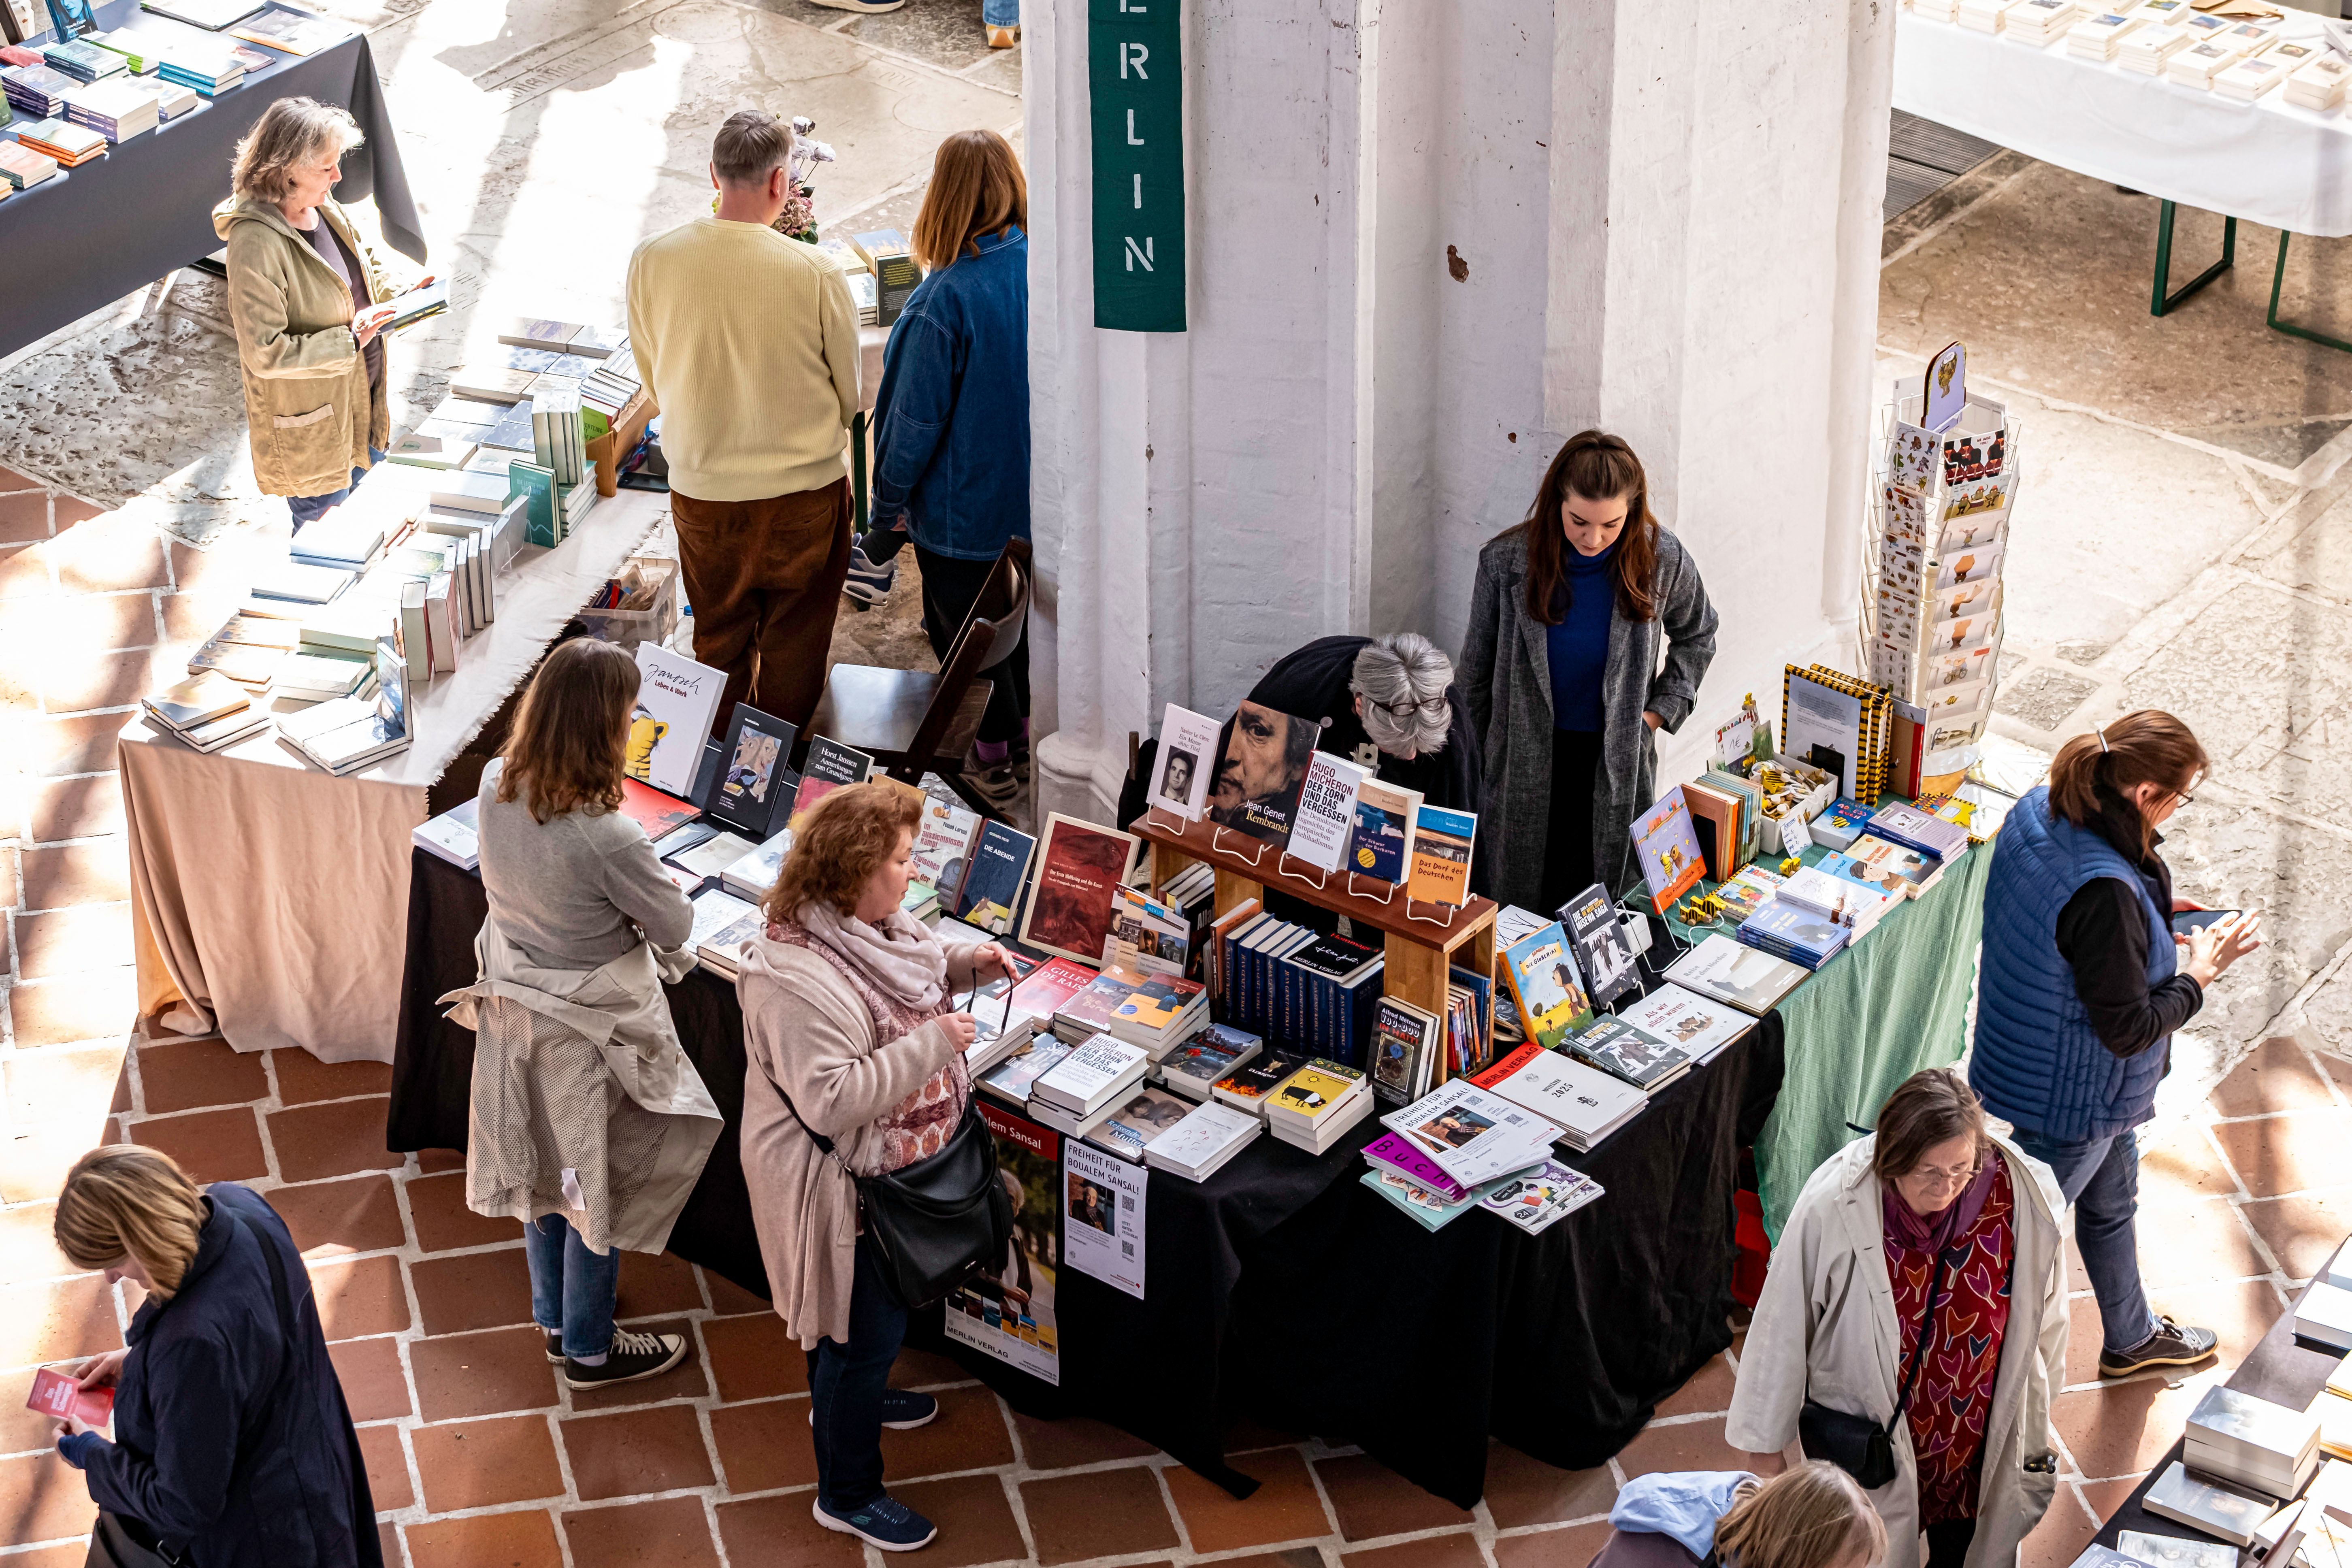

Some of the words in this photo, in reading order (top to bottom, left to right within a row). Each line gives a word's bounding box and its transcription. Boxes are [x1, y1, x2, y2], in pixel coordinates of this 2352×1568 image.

[644, 664, 702, 695] Janosch
[655, 680, 669, 690] Leben
[675, 688, 687, 697] Werk
[1187, 737, 1201, 746] Mann
[820, 758, 853, 775] Anmerkungen
[821, 747, 837, 759] Horst
[837, 754, 857, 768] Janssen
[1312, 761, 1336, 778] HUGO
[1307, 780, 1323, 793] DER
[1324, 787, 1346, 803] ZORN
[1309, 770, 1354, 796] MICHERON
[1304, 789, 1321, 803] UND
[1322, 795, 1338, 810] DAS
[1244, 799, 1262, 812] Jean
[1264, 806, 1286, 821] Genet
[1302, 798, 1348, 824] VERGESSEN
[1246, 809, 1289, 833] Rembrandt
[1297, 816, 1325, 831] angesichts
[1326, 827, 1335, 835] des
[1300, 808, 1309, 816] Die
[1310, 812, 1344, 832] Demokratien
[922, 831, 964, 848] aussichtslosen
[1293, 829, 1334, 851] Dschihadismus
[1295, 822, 1331, 841] europäischen
[920, 837, 938, 848] Kampf
[1368, 838, 1385, 847] Schwur
[1374, 846, 1395, 856] Barbaren
[984, 844, 993, 852] DIE
[993, 849, 1015, 862] ABENDE
[1418, 867, 1454, 882] Deutschen
[1419, 859, 1431, 867] Das
[1433, 863, 1449, 872] Dorf
[1451, 867, 1463, 875] des
[1129, 894, 1144, 904] NEXUS
[1148, 906, 1163, 916] NEXUS
[1572, 910, 1583, 923] DIE
[1575, 914, 1596, 931] MISEWA
[1596, 903, 1609, 918] SAGA
[1293, 956, 1319, 967] MERLIN
[1319, 965, 1343, 975] VERLAG
[1683, 965, 1700, 977] Reise
[1700, 967, 1711, 975] den
[1707, 952, 1728, 968] Norden
[1040, 971, 1058, 980] DE
[1057, 978, 1085, 991] RAIS
[1051, 967, 1089, 984] GILLES
[1083, 995, 1102, 1005] Rue
[1382, 1008, 1398, 1019] Alfred
[1399, 1015, 1421, 1029] Métraux
[1645, 1009, 1658, 1018] Als
[1656, 1002, 1668, 1011] wir
[1647, 1016, 1666, 1028] allein
[1664, 1002, 1686, 1016] waren
[1379, 1023, 1389, 1032] IN
[1392, 1028, 1419, 1045] HAITI
[1381, 1013, 1419, 1038] VOO-DOO
[1093, 1037, 1118, 1048] HUGO
[1581, 1033, 1607, 1048] MISEWA
[1604, 1023, 1622, 1035] SAGA
[1076, 1050, 1094, 1059] UND
[1093, 1057, 1112, 1066] DAS
[1082, 1046, 1099, 1055] DER
[1099, 1052, 1123, 1064] ZORN
[1087, 1041, 1134, 1061] MICHERON
[1005, 1057, 1022, 1068] Das
[1070, 1055, 1119, 1076] VERGESSEN
[1480, 1068, 1510, 1085] MERLIN
[1506, 1047, 1538, 1069] VERLAG
[1541, 1078, 1562, 1092] NOVITÄTEN
[1551, 1082, 1574, 1098] 2025
[1394, 1102, 1427, 1122] FREIHEIT
[1426, 1093, 1444, 1104] FÜR
[1405, 1106, 1441, 1127] BOUALEM
[1440, 1088, 1470, 1107] SANSAL!
[1010, 1127, 1042, 1150] Sansal
[1108, 1121, 1140, 1138] Reisende
[1112, 1131, 1145, 1147] Mutter
[1068, 1144, 1103, 1166] FREIHEIT
[1106, 1160, 1121, 1174] FÜR
[1068, 1157, 1105, 1180] BOUALEM
[1107, 1174, 1139, 1195] SANSAL!
[947, 1325, 976, 1343] MERLIN
[977, 1339, 1008, 1358] VERLAG
